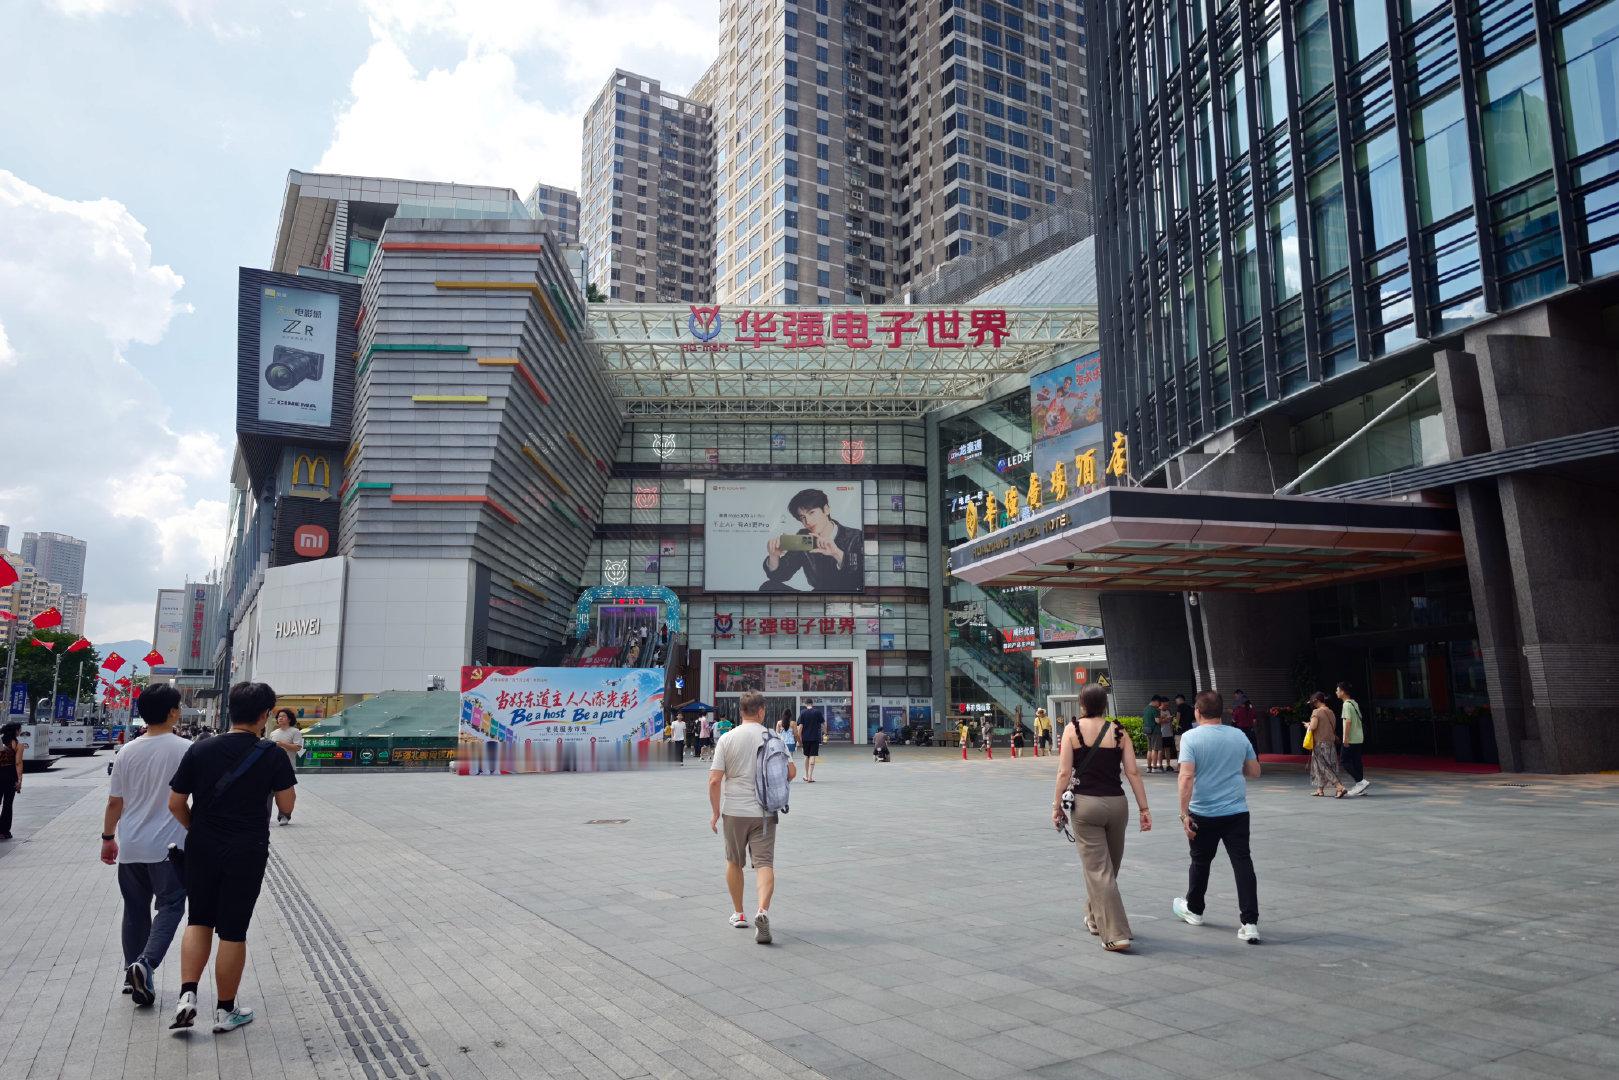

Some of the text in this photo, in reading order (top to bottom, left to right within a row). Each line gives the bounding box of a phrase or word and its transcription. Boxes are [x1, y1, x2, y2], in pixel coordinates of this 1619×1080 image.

[304, 324, 314, 336] R
[735, 309, 1011, 349] 华强电子世界
[275, 617, 321, 639] HUAWEI
[739, 616, 857, 635] 华强电子世界
[510, 708, 624, 726] Be a host Be a part
